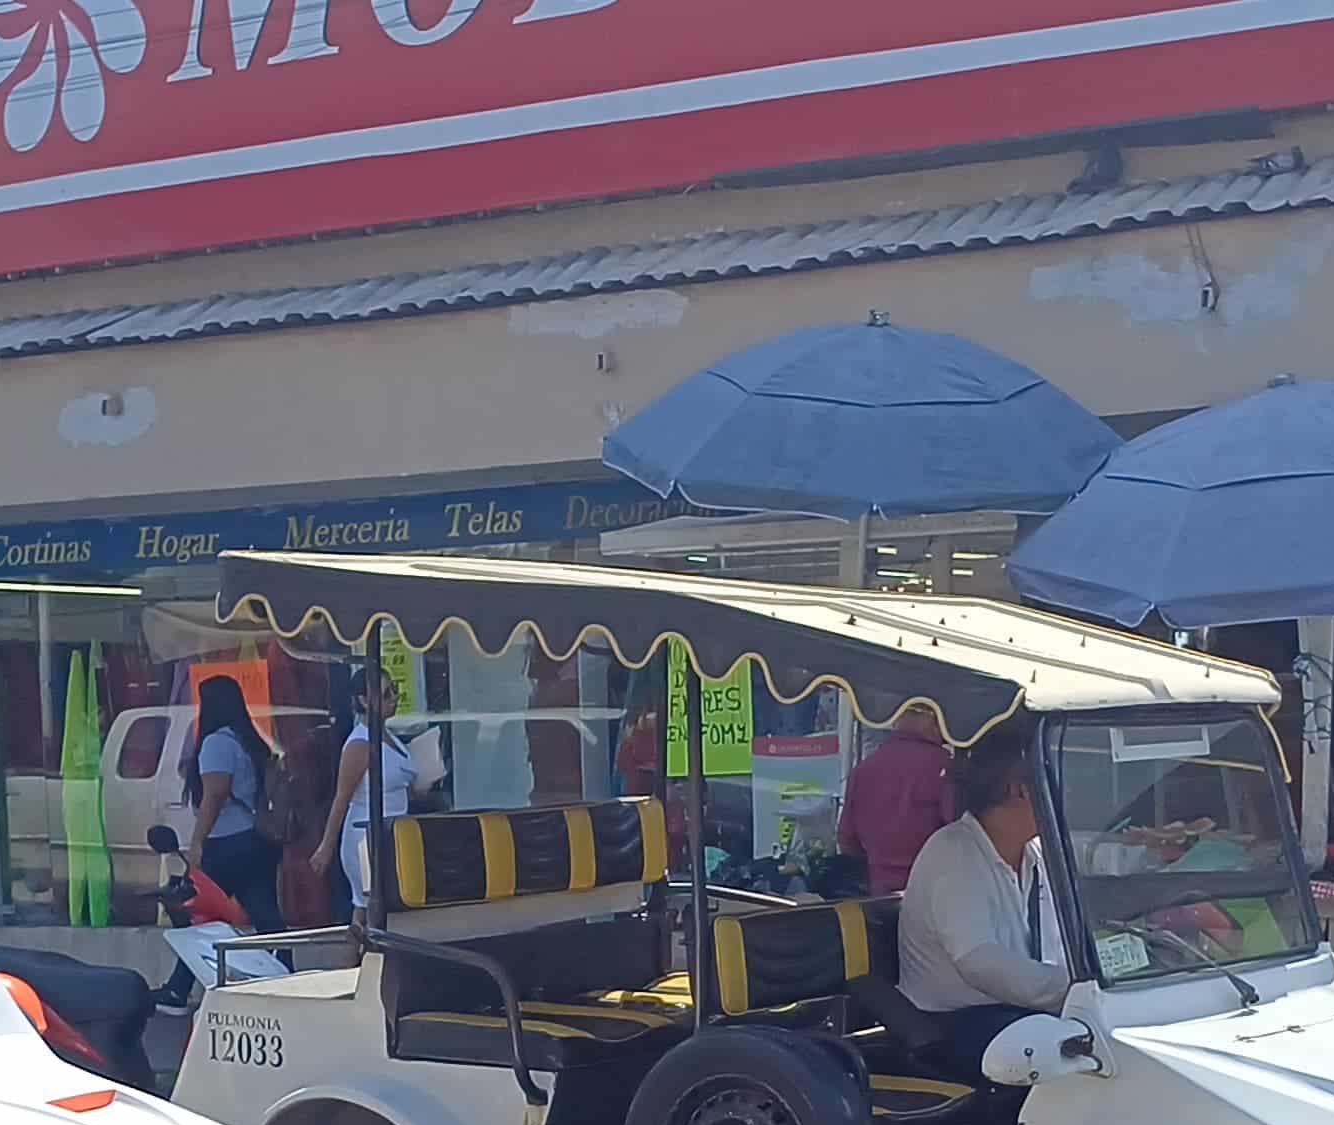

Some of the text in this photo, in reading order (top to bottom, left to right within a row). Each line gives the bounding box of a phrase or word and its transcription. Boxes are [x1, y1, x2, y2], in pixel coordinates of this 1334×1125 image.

[135, 526, 220, 562] Hogar
[444, 501, 524, 538] Telas
[208, 1012, 282, 1031] PULMONIA
[208, 1029, 284, 1068] 12033
